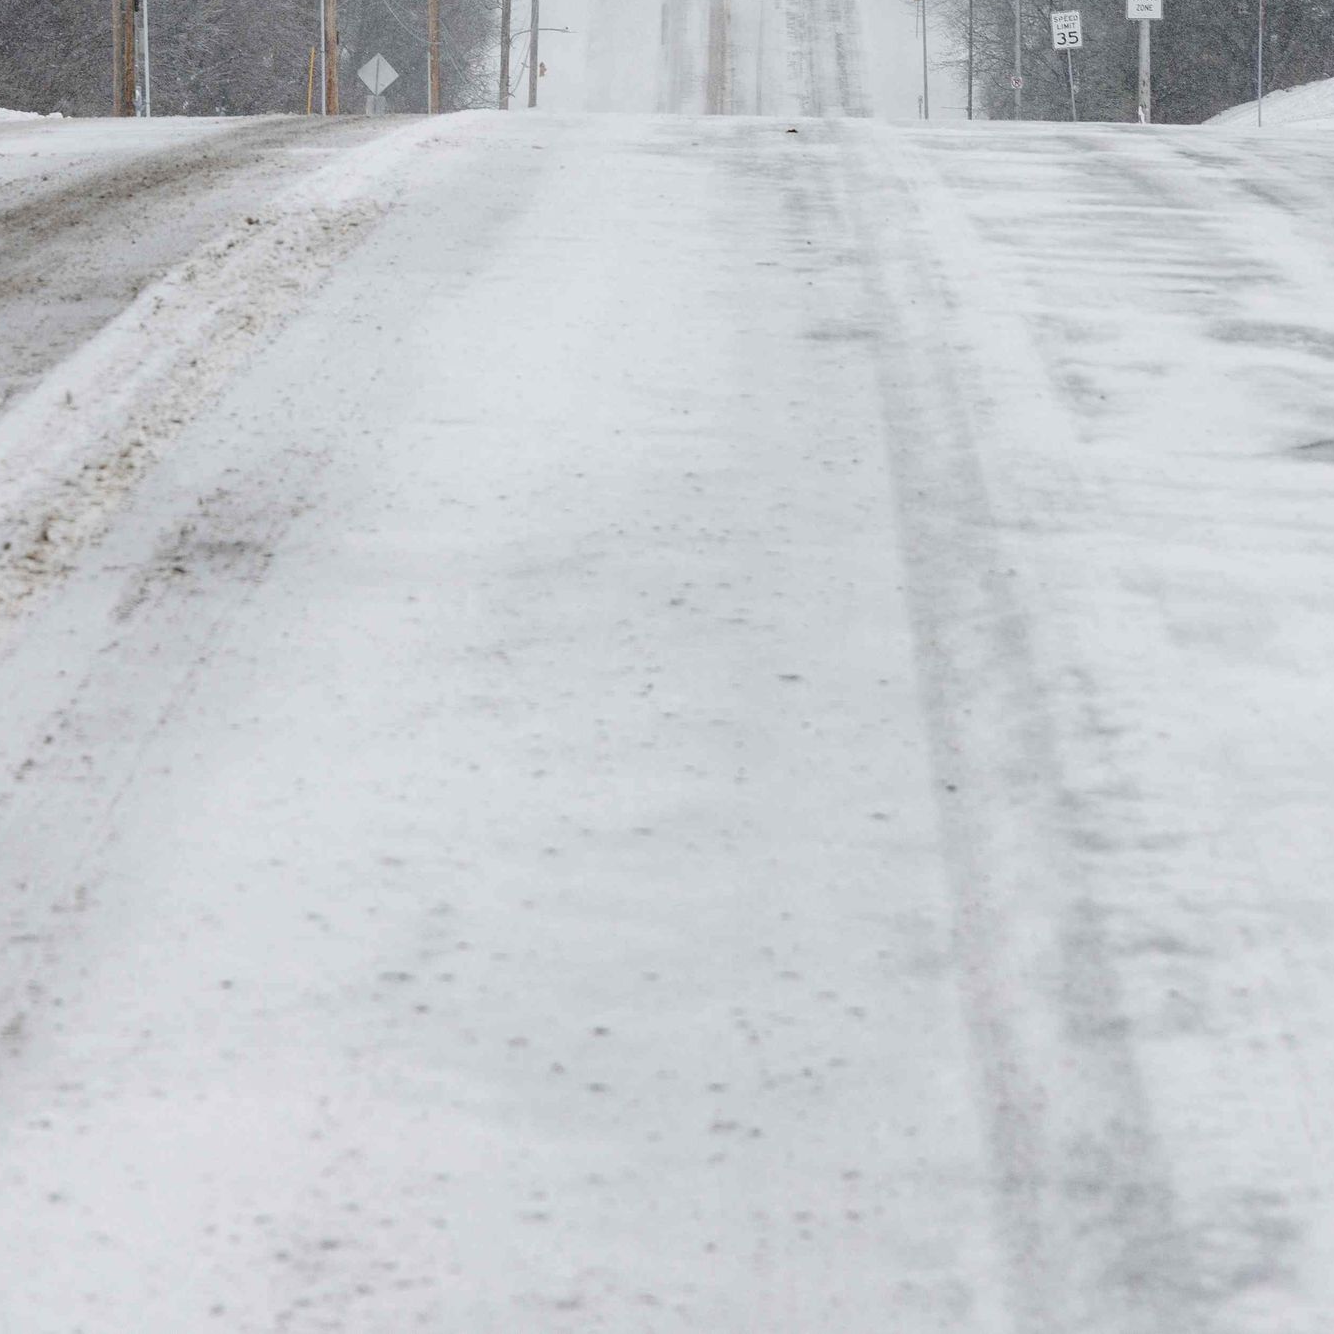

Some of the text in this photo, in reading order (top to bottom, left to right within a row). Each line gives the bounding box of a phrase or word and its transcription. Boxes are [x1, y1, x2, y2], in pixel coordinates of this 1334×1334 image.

[1136, 4, 1153, 12] ZONE
[1053, 14, 1078, 23] SPEED
[1056, 22, 1075, 30] LIMIT
[1057, 31, 1079, 45] 35
